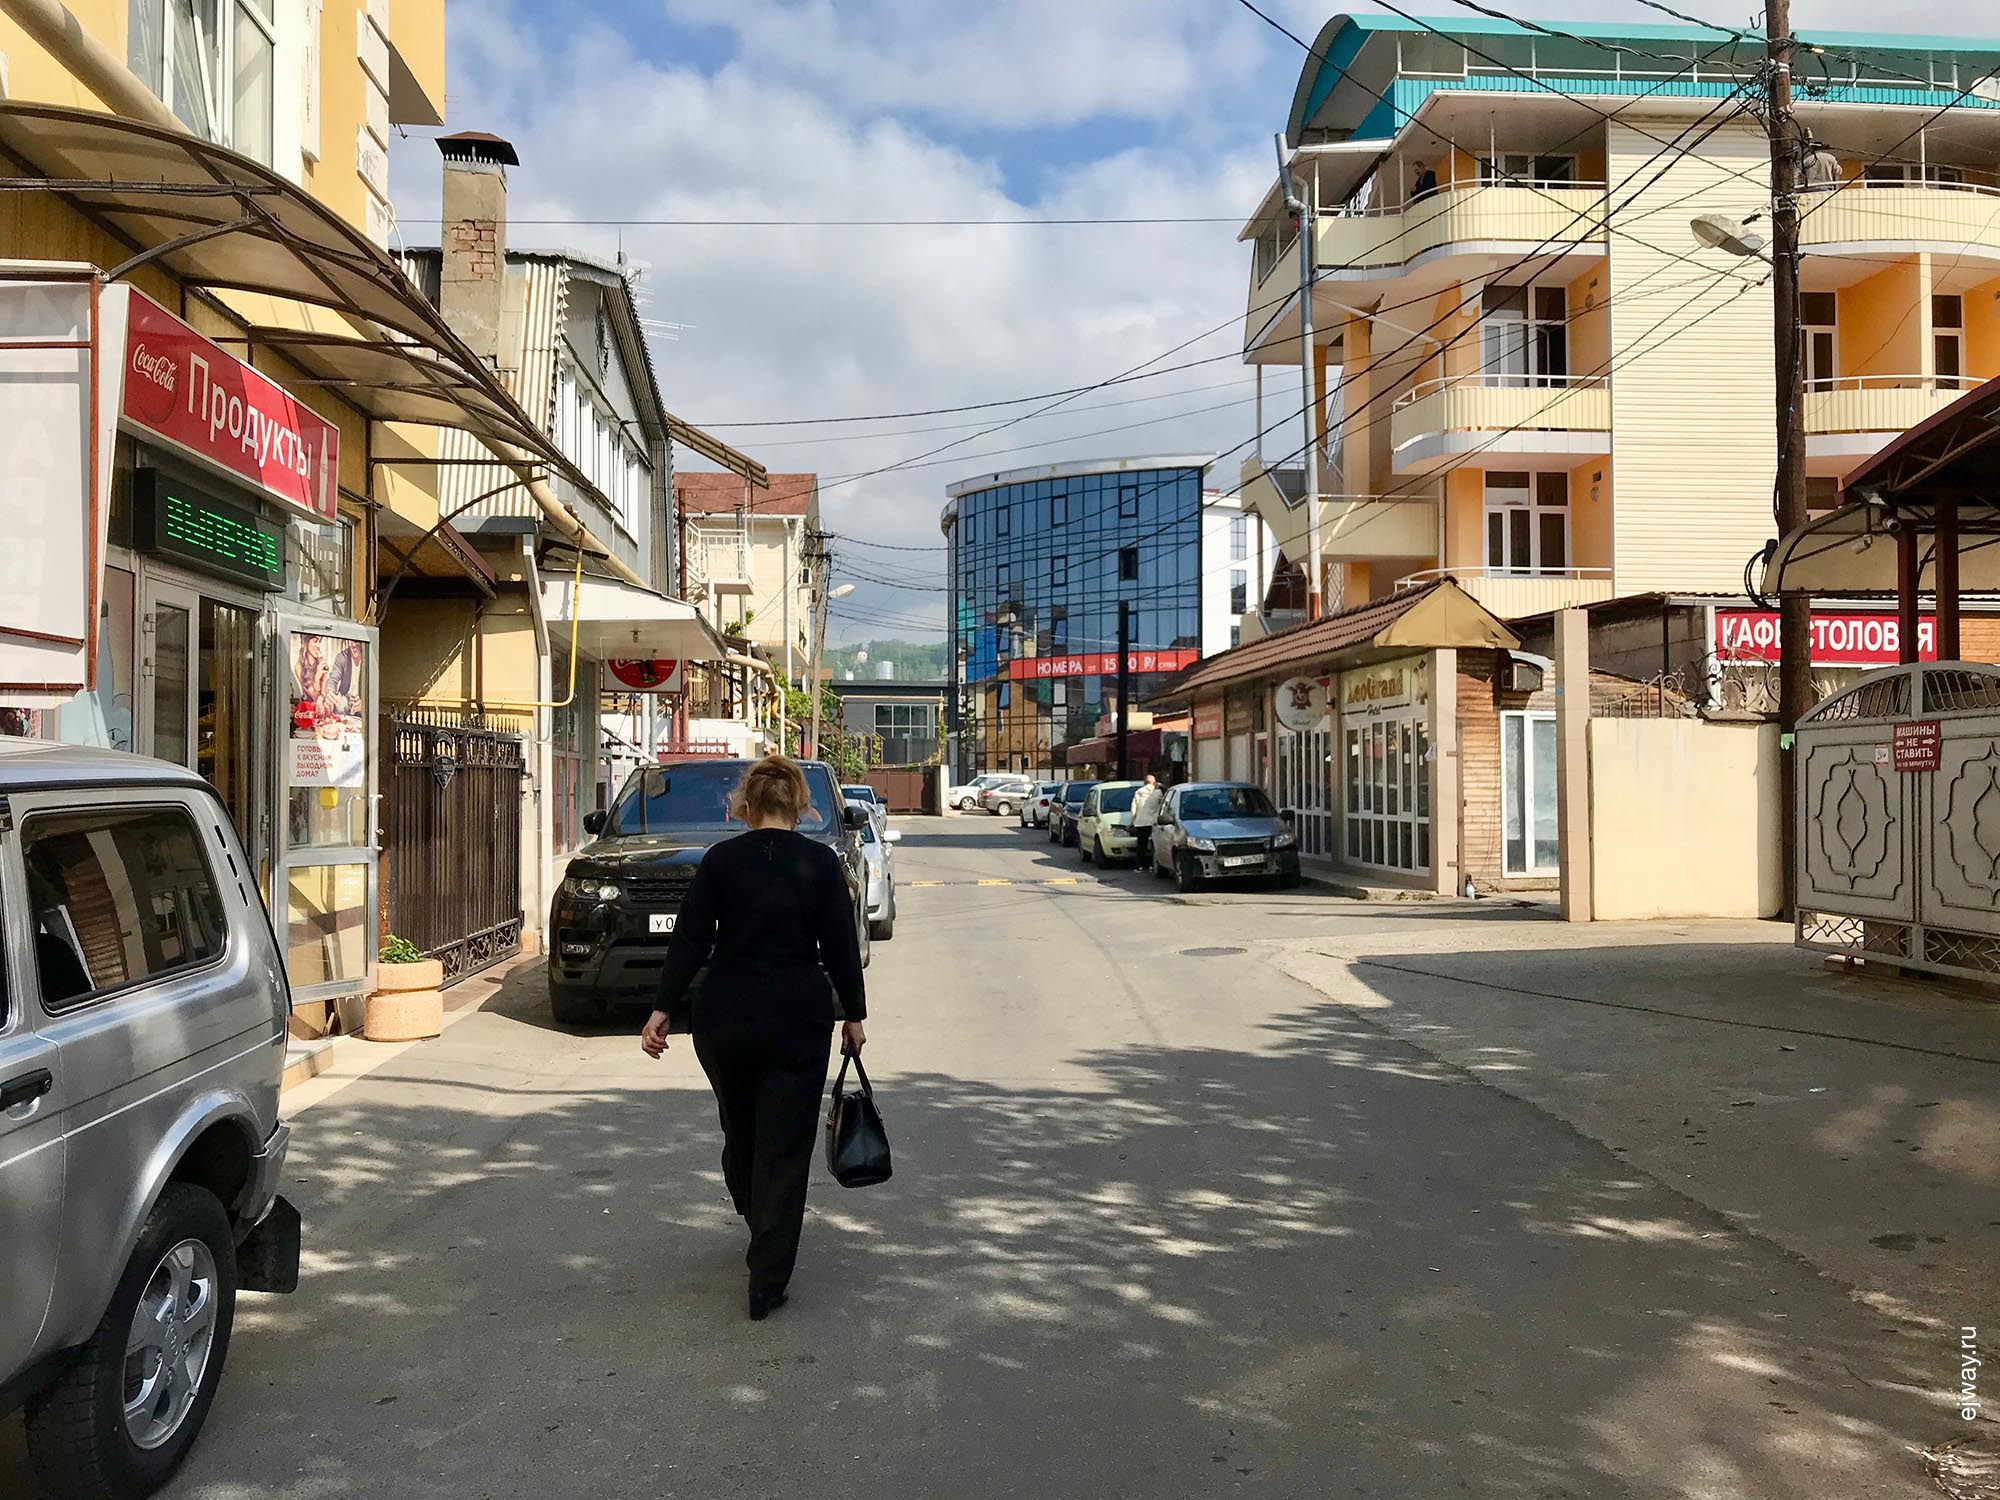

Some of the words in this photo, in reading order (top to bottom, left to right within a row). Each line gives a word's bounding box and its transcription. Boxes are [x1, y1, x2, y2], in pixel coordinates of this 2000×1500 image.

[133, 343, 178, 391] Coca-Cola
[187, 351, 312, 480] Продукты
[1810, 620, 1933, 652] ТОЛОВЯ
[1037, 660, 1083, 674] НОМЕРА
[1103, 657, 1137, 671] 150
[1896, 725, 1936, 737] МАШИНЫ
[1906, 738, 1918, 746] НЕ
[1895, 748, 1934, 760] СТАВИТЬ
[296, 770, 319, 778] ДОМА?
